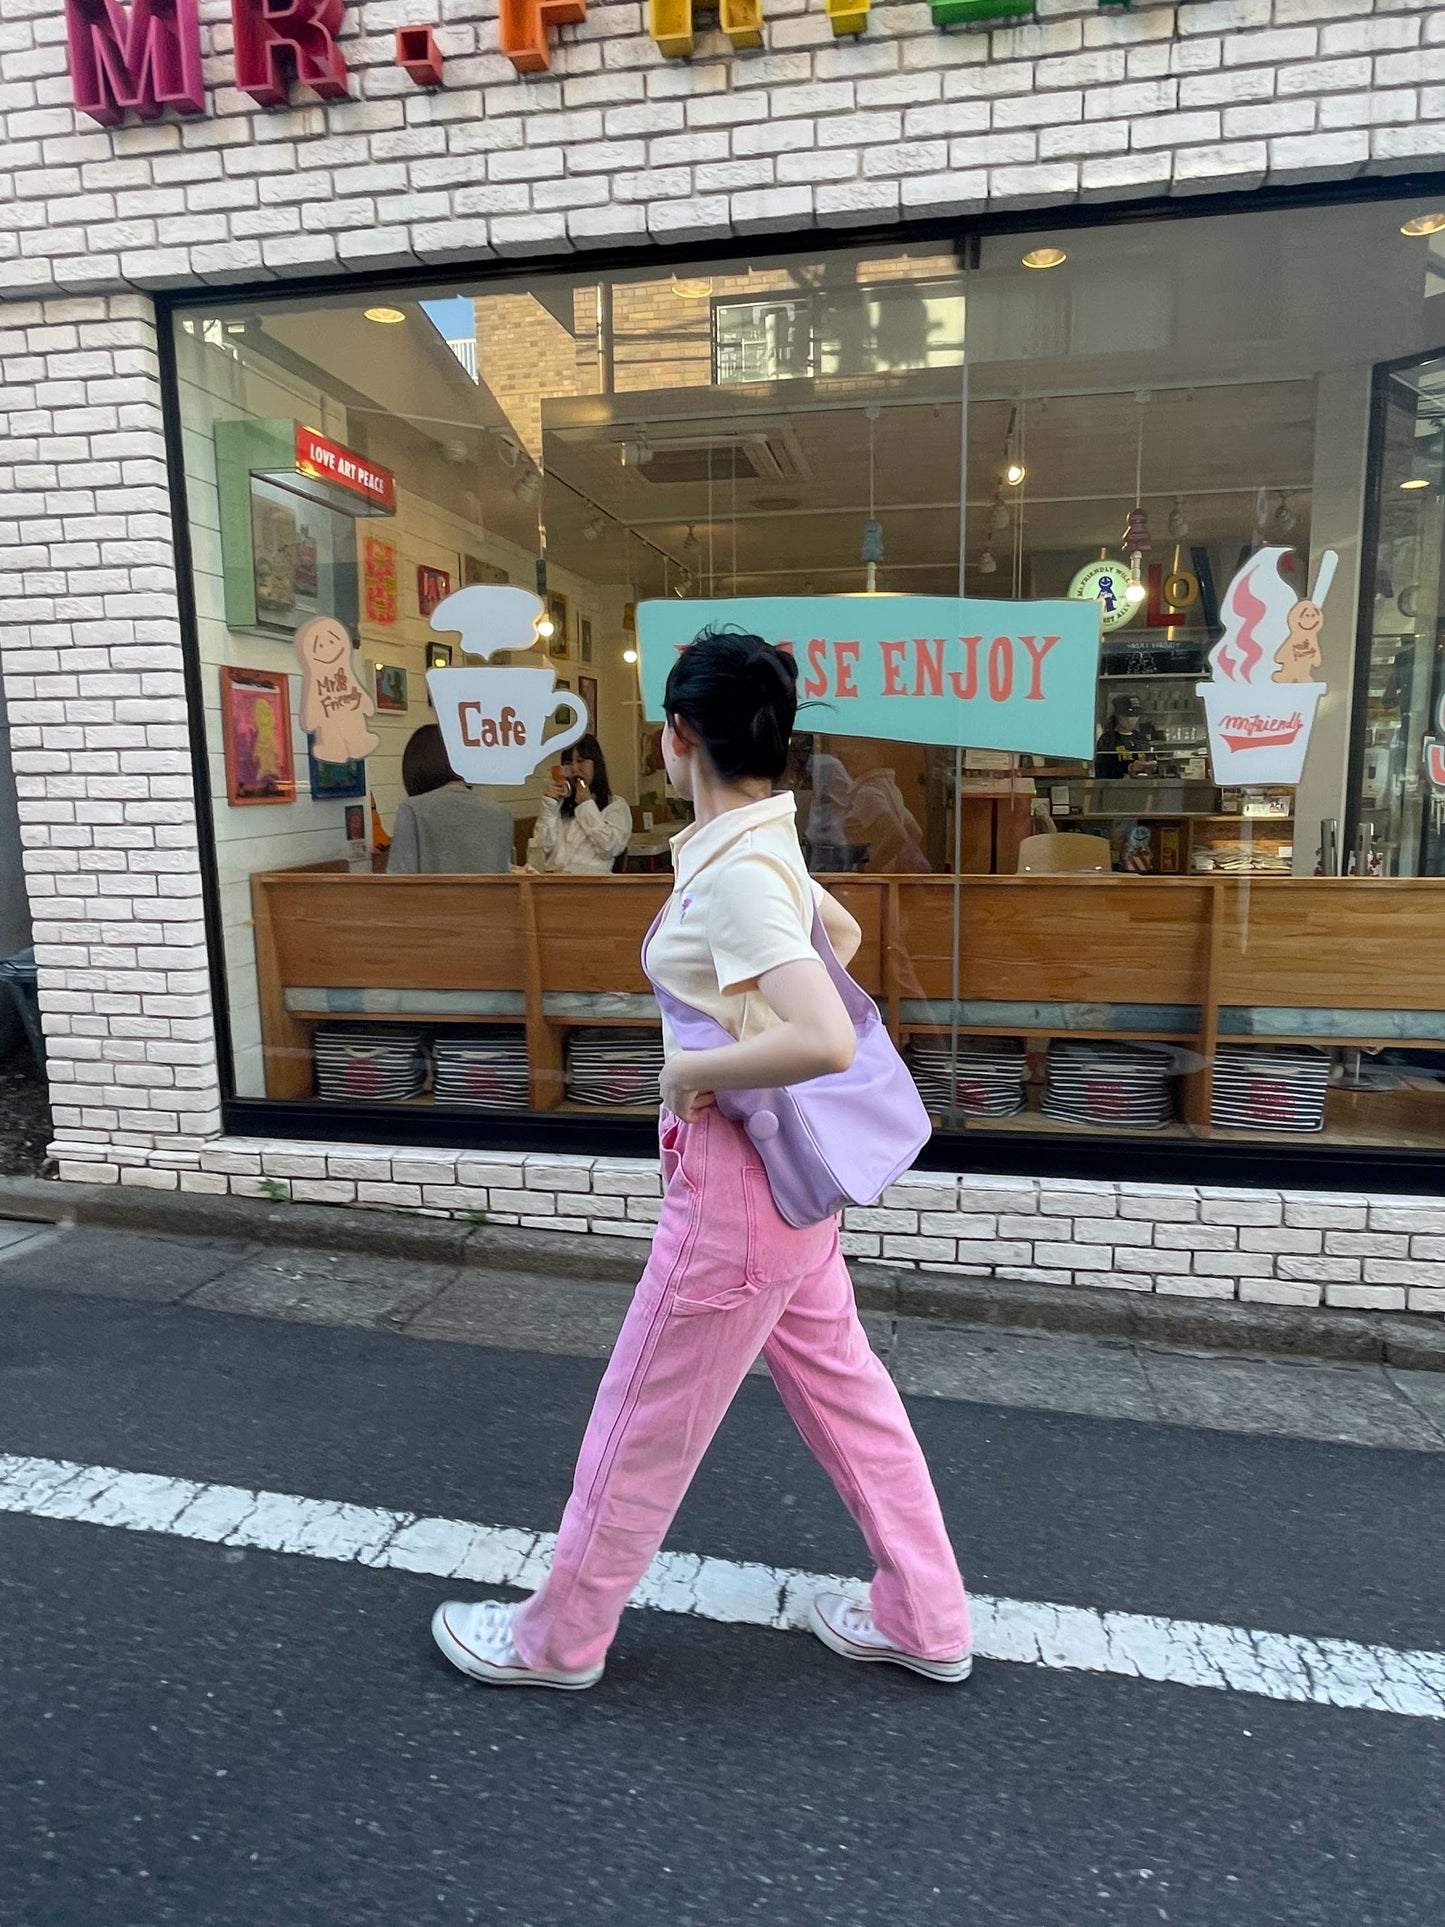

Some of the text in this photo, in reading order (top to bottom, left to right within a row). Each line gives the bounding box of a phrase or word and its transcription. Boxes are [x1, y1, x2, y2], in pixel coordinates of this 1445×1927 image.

[310, 443, 384, 494] LOVE ART PEACE
[878, 636, 1062, 702] ENJOY
[458, 701, 526, 747] Cafe
